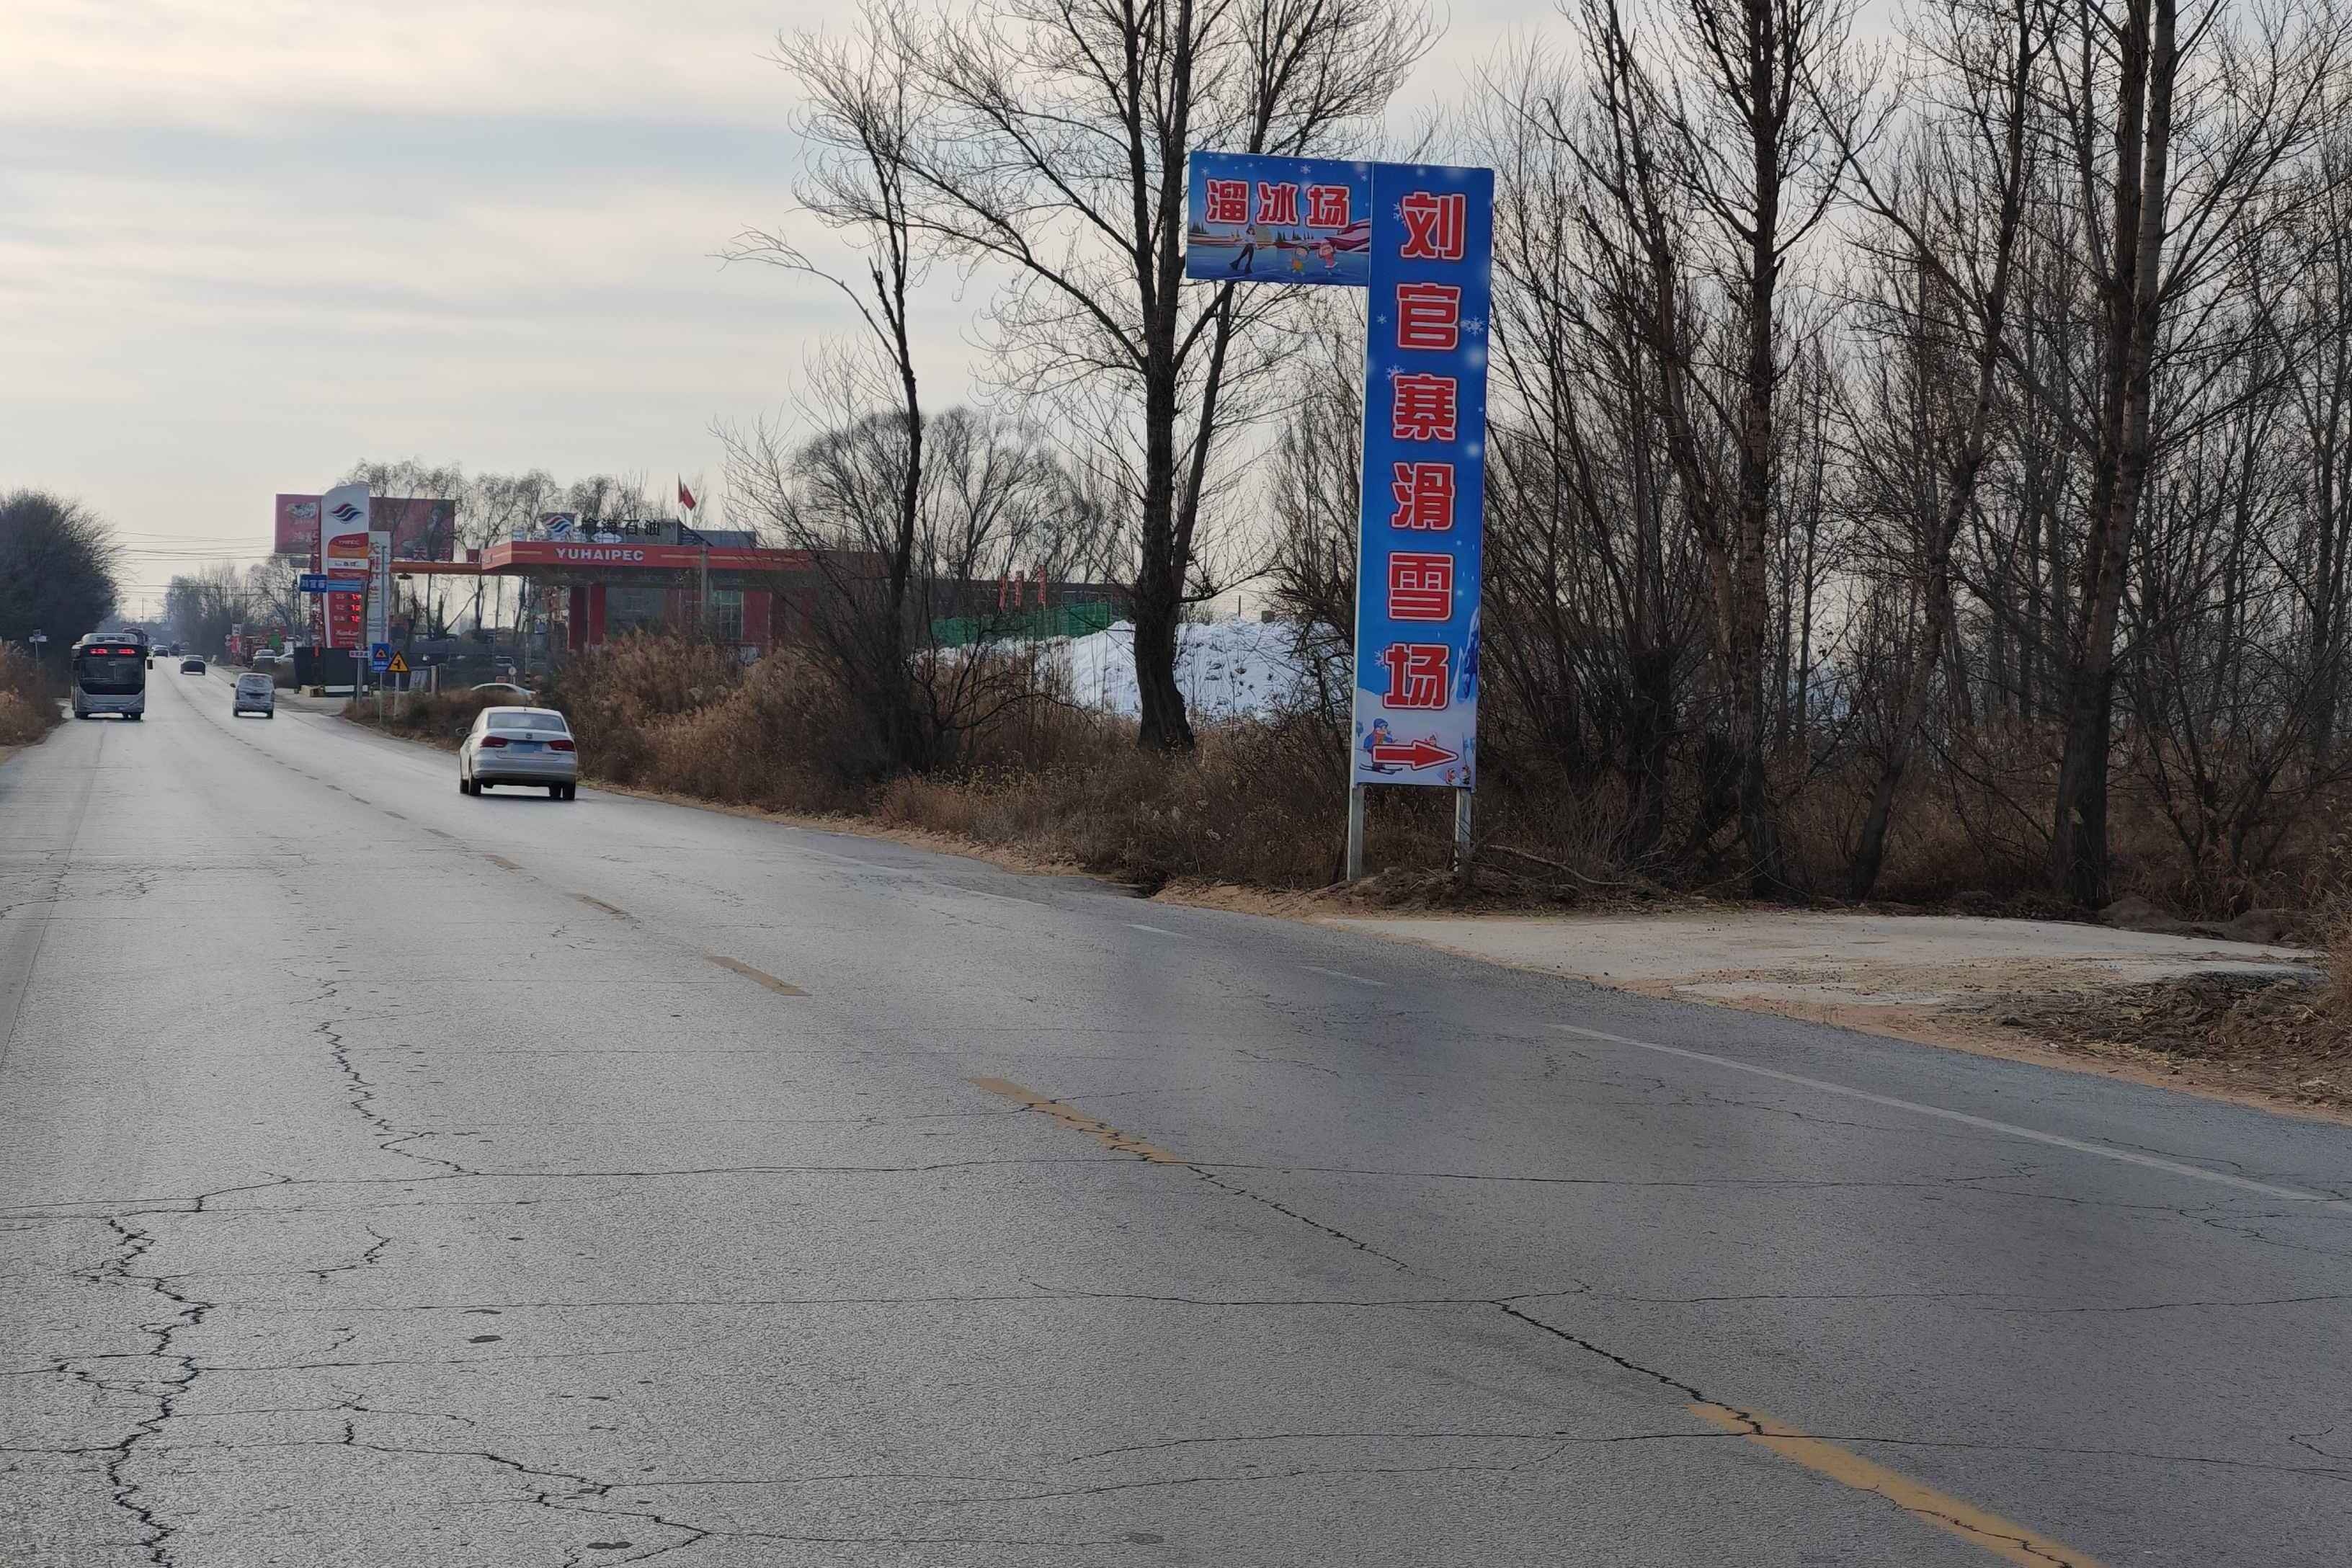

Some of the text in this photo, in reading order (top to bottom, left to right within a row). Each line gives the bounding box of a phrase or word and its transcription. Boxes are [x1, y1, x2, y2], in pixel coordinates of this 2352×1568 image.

[1206, 179, 1350, 229] 溜冰场
[1383, 190, 1467, 710] 刘官寨滑雪场
[555, 547, 644, 561] YUHAIPEC
